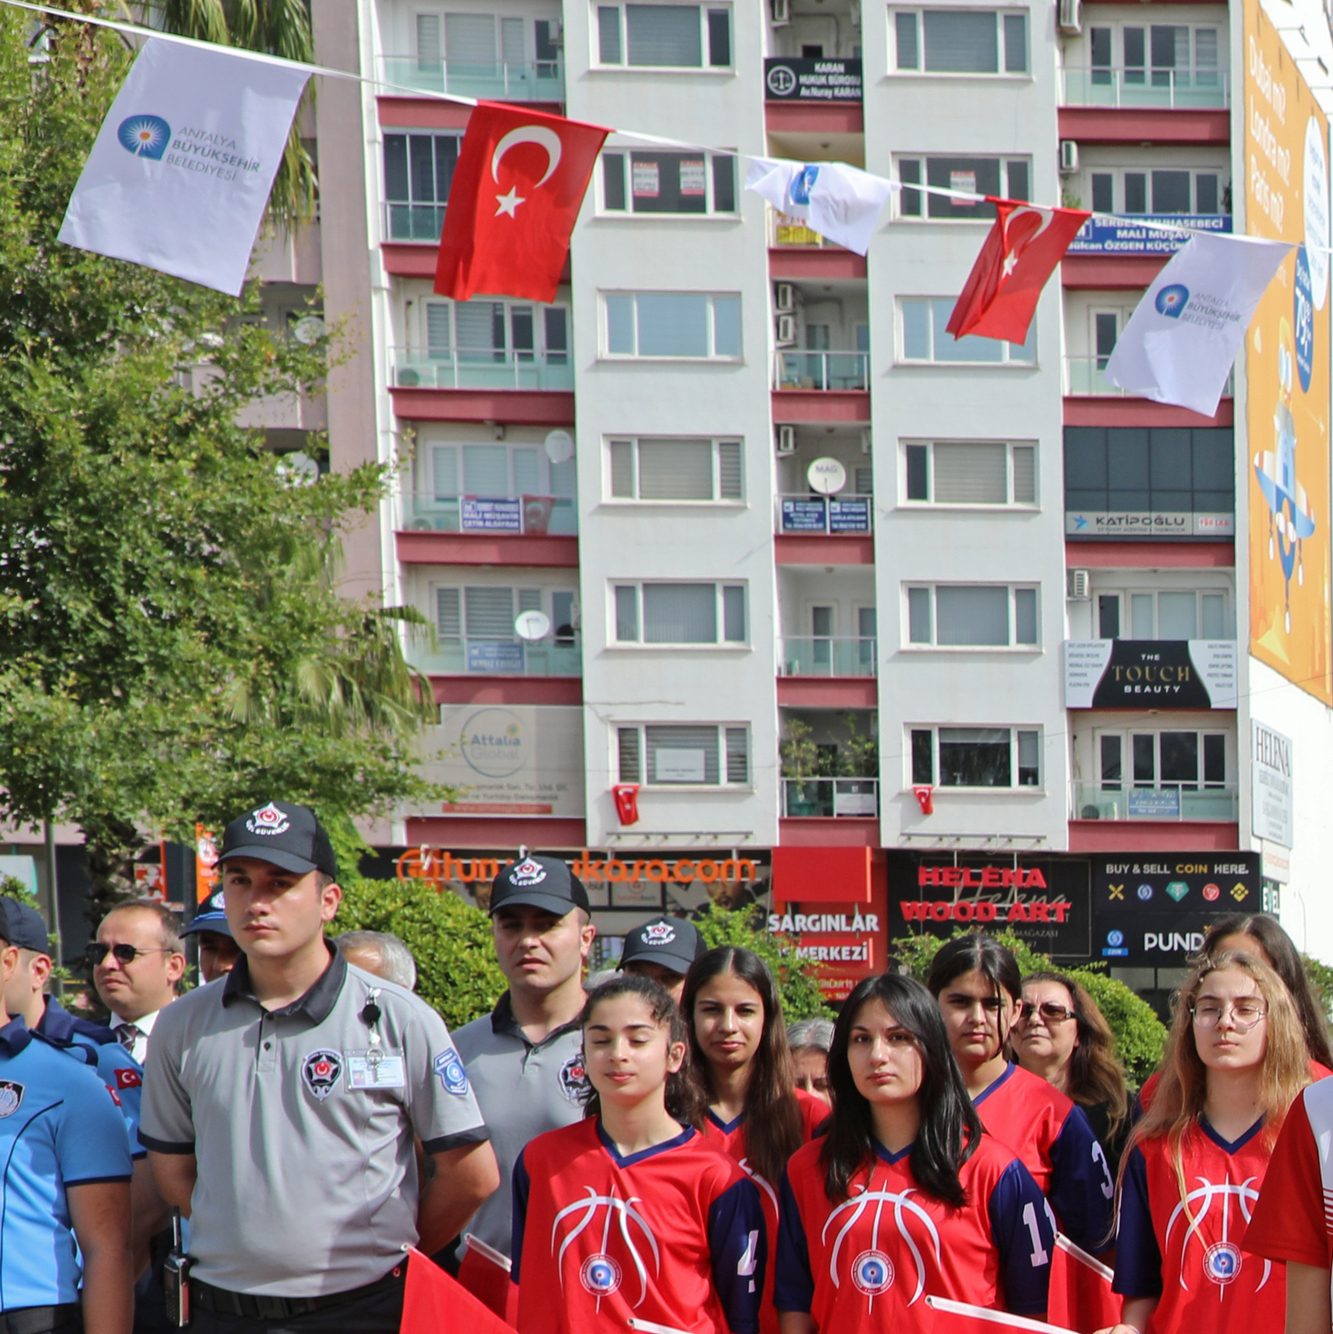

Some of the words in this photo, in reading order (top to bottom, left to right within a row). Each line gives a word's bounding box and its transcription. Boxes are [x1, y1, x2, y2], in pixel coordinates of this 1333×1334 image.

[178, 126, 236, 150] ANTALYA
[172, 138, 260, 173] BÜYÜKŞEHİR
[166, 152, 237, 182] BELEDİYESİ
[1117, 228, 1146, 239] MALİ
[1105, 240, 1144, 250] ÖZGEN
[1095, 515, 1185, 526] KATİPOĞLU
[1112, 665, 1191, 682] TOUCH
[1124, 685, 1181, 694] BEAUTY
[470, 734, 521, 746] Attalia
[1256, 727, 1290, 777] HELENA
[918, 865, 1047, 888] HELENA
[1106, 864, 1130, 874] BUY
[1132, 864, 1141, 874] &
[1143, 864, 1171, 874] SELL
[1175, 864, 1208, 874] COIN
[1214, 864, 1249, 875] HERE.
[900, 901, 998, 922] WOOD
[1006, 902, 1072, 923] ART
[768, 914, 880, 932] SARGINLAR
[795, 941, 868, 961] MERKEZİ
[1091, 1140, 1114, 1200] 3
